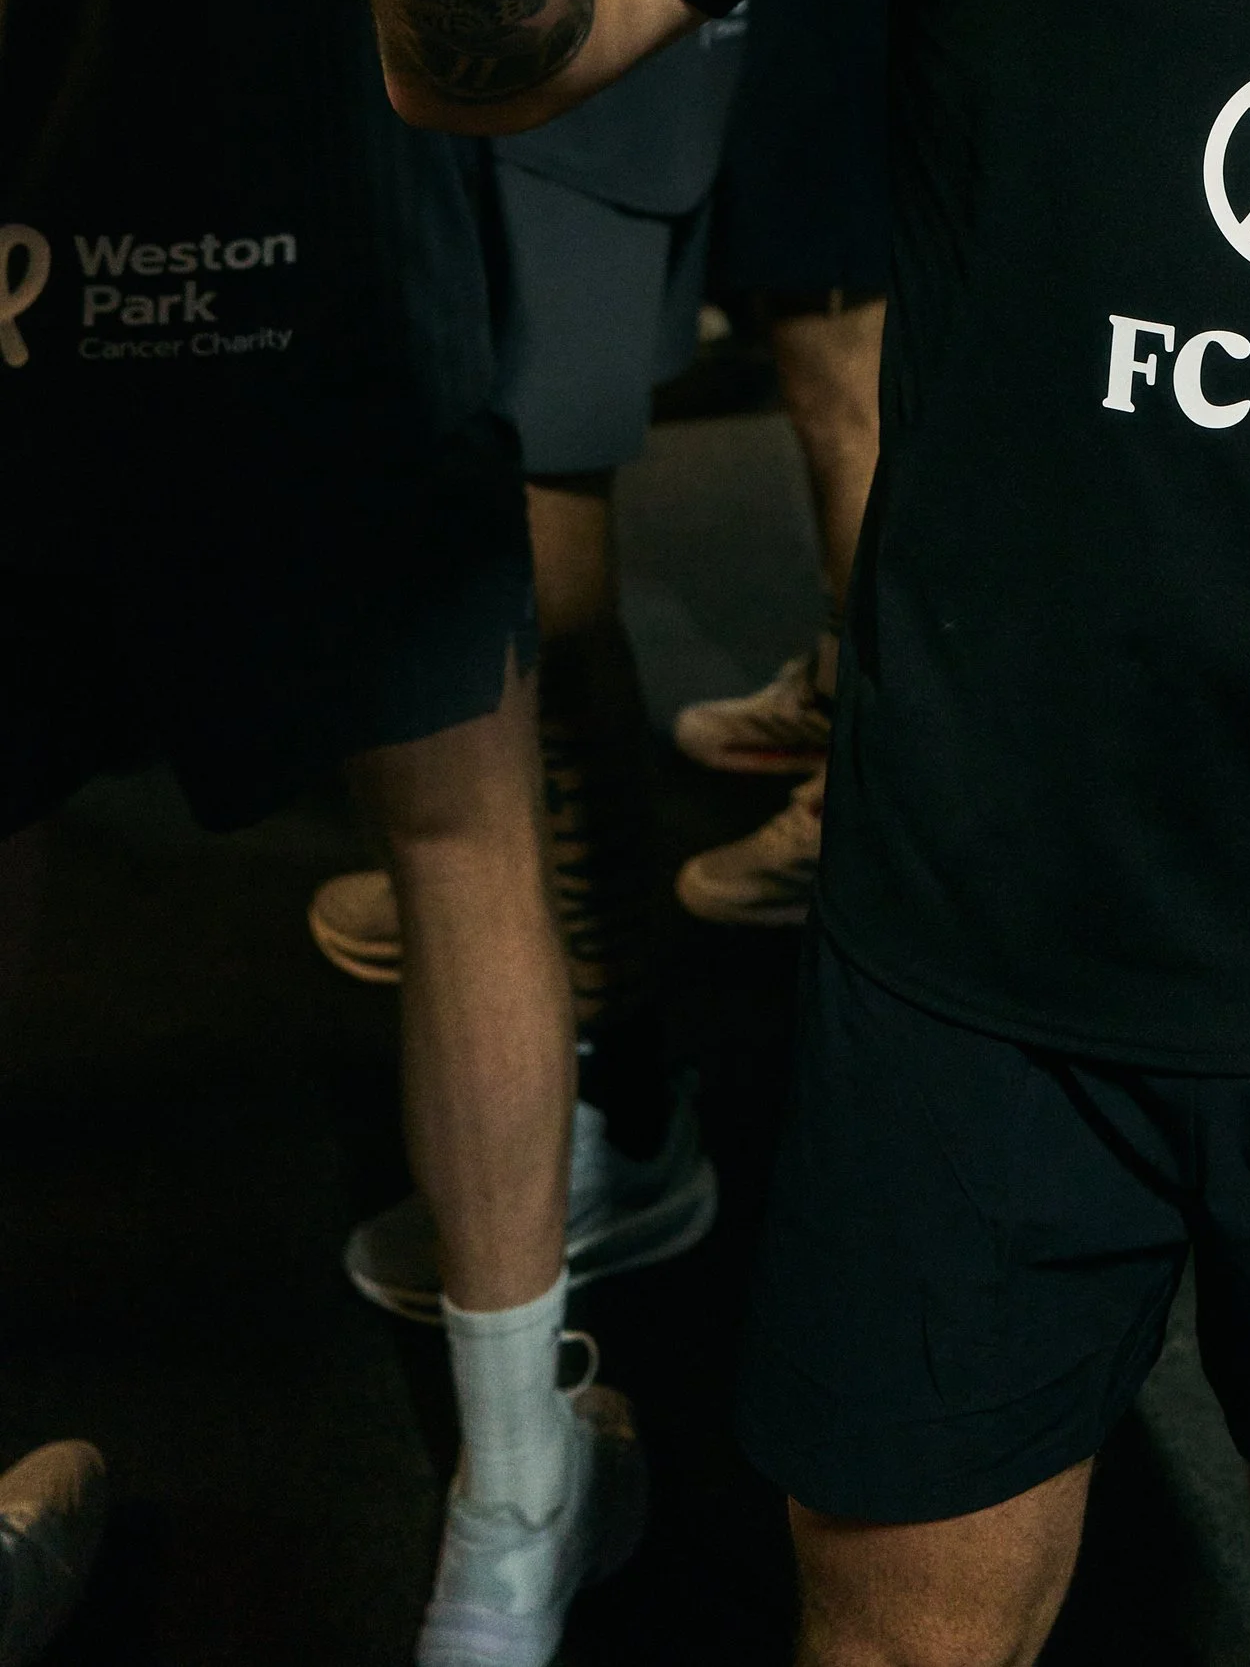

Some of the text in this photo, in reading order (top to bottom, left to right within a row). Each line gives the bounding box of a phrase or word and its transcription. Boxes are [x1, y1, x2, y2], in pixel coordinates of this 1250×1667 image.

[73, 232, 298, 277] Weston
[82, 280, 219, 327] Park
[78, 328, 293, 360] Cancer Charity
